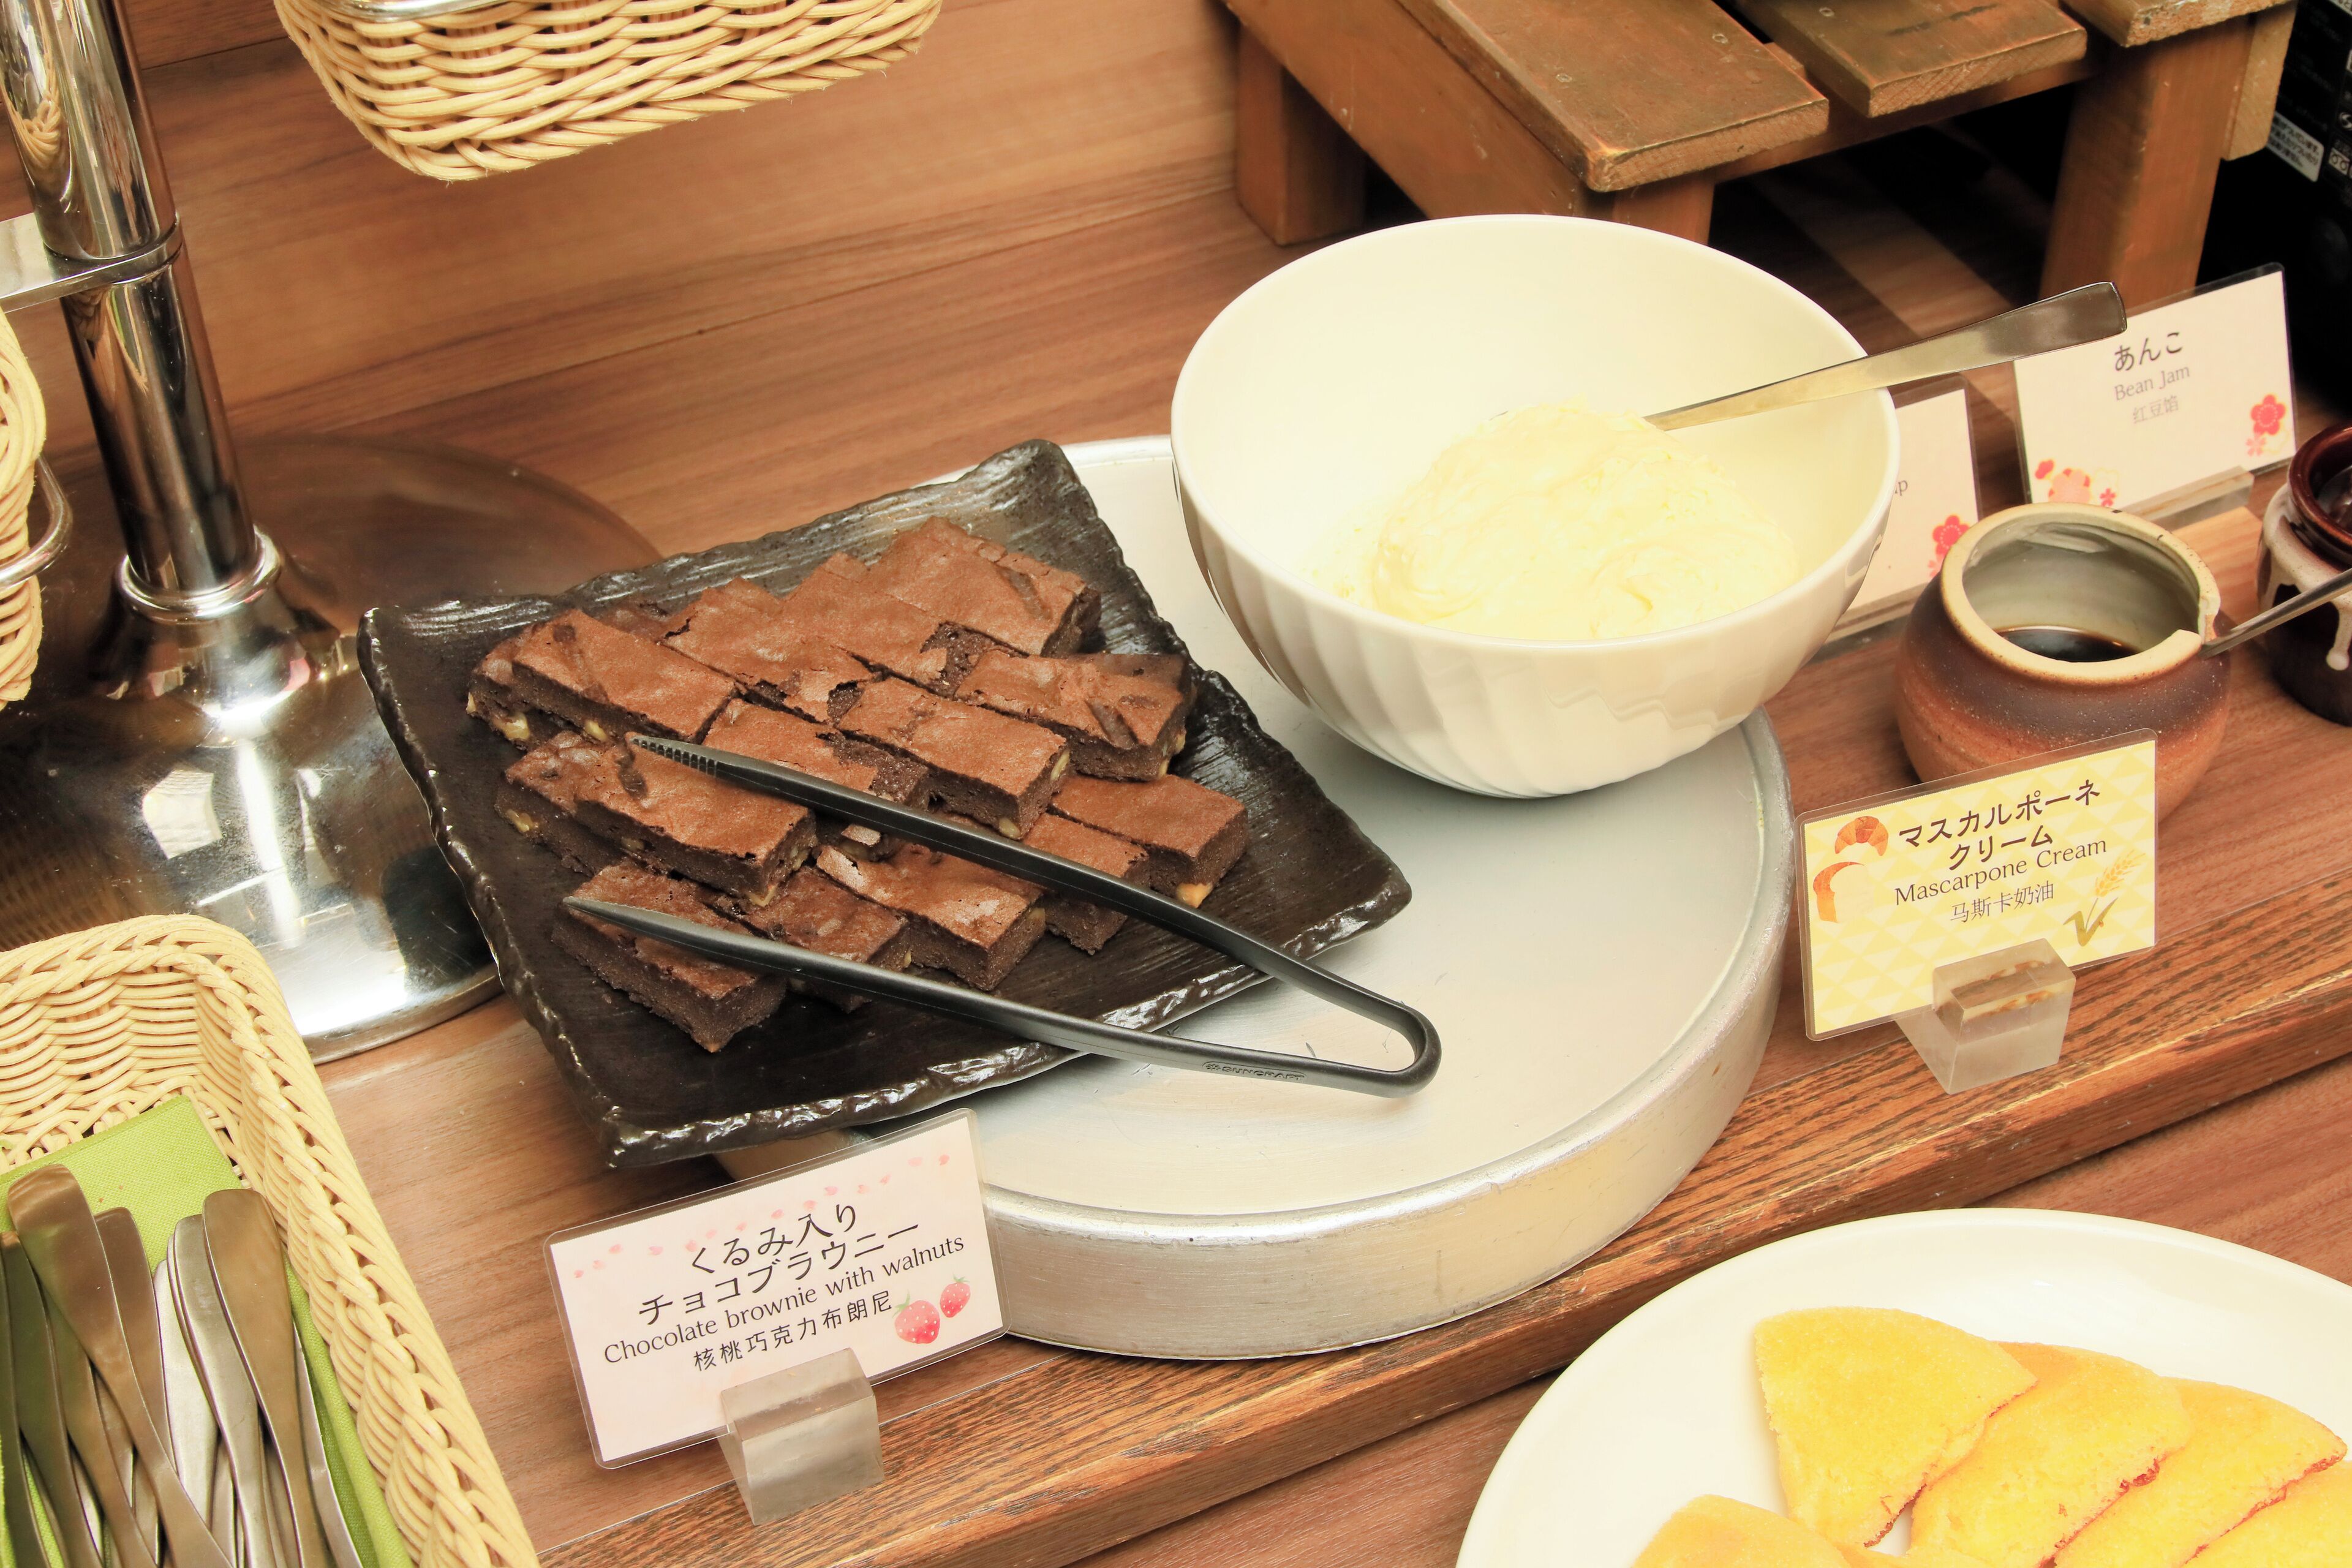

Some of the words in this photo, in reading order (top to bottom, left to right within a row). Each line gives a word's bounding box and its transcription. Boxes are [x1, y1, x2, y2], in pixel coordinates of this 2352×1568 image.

[2114, 332, 2183, 371] あんこ
[2114, 378, 2154, 401] Bean
[2159, 367, 2190, 389] Jam
[1899, 779, 2100, 848] マスカルポーネ
[1894, 860, 2027, 905] Mascarpone
[2037, 840, 2107, 868] Cream
[1949, 825, 2053, 870] クリーム
[1950, 881, 2054, 922] 马斯卡奶油
[1222, 1066, 1305, 1080] SUNCRAFT
[692, 1204, 858, 1275] くるみ入り
[604, 1316, 718, 1363] Chocolate
[727, 1287, 818, 1329] brownie
[825, 1266, 875, 1298] with
[883, 1234, 964, 1277] walnuts
[639, 1224, 919, 1325] チョコブラウニー
[694, 1290, 893, 1371] 核桃巧克力布朗尼
